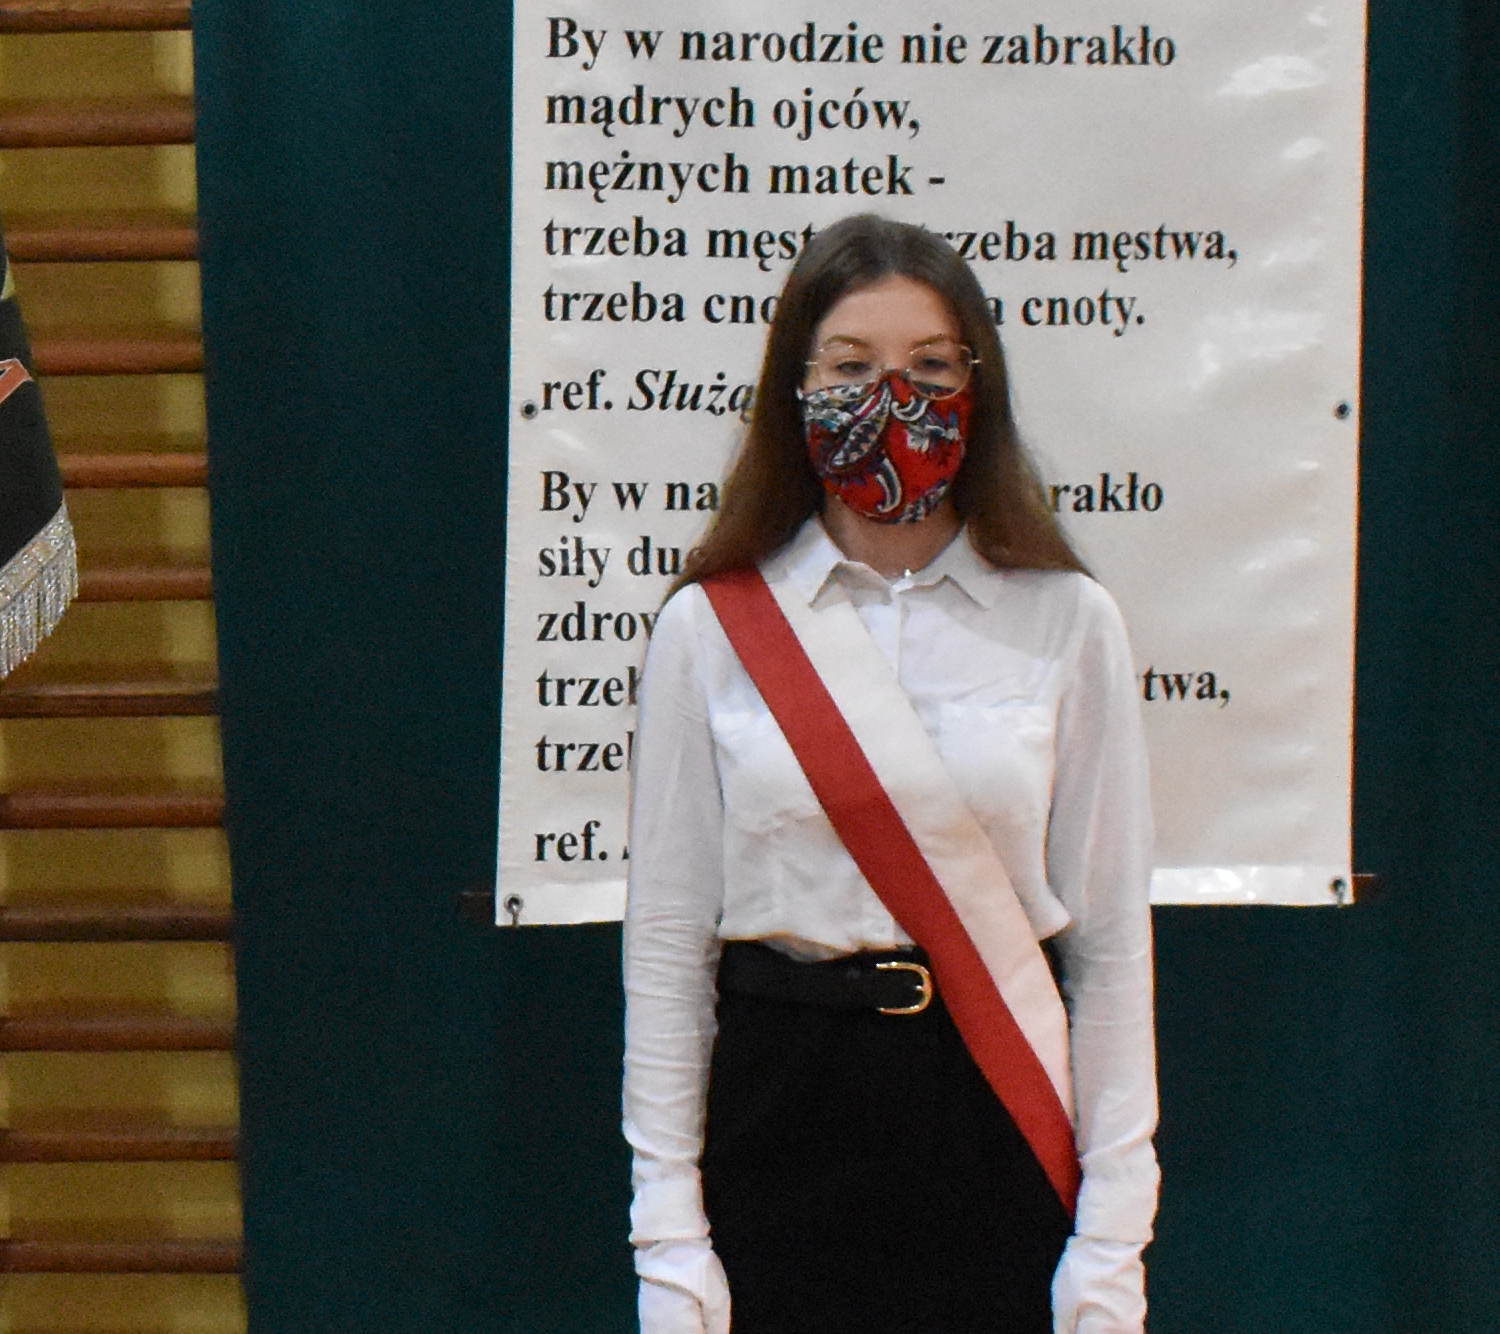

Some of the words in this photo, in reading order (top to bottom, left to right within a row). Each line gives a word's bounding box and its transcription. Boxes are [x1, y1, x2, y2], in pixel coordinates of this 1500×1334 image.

[545, 16, 608, 72] By
[623, 29, 664, 60] w
[678, 20, 885, 65] narodzie
[900, 22, 968, 66] nie
[980, 23, 1177, 67] zabrakło
[545, 83, 756, 139] mądrych
[772, 86, 921, 142] ojców,
[544, 149, 751, 205] mężnych
[768, 153, 915, 196] matek
[542, 215, 689, 258] trzeba
[705, 222, 818, 272] męst
[938, 221, 1057, 263] zeba
[1071, 223, 1239, 274] męstwa,
[541, 280, 687, 323] trzeba
[703, 292, 778, 324] cno
[1020, 288, 1146, 338] cnoty.
[541, 368, 614, 412] ref.
[627, 369, 758, 424] Służą
[539, 470, 599, 524] By
[611, 481, 650, 512] w
[1050, 471, 1165, 513] rakło
[538, 535, 611, 589] siły
[536, 665, 640, 707] trze
[1142, 666, 1231, 708] twa,
[535, 731, 636, 772] trze
[534, 832, 609, 863] ref.
